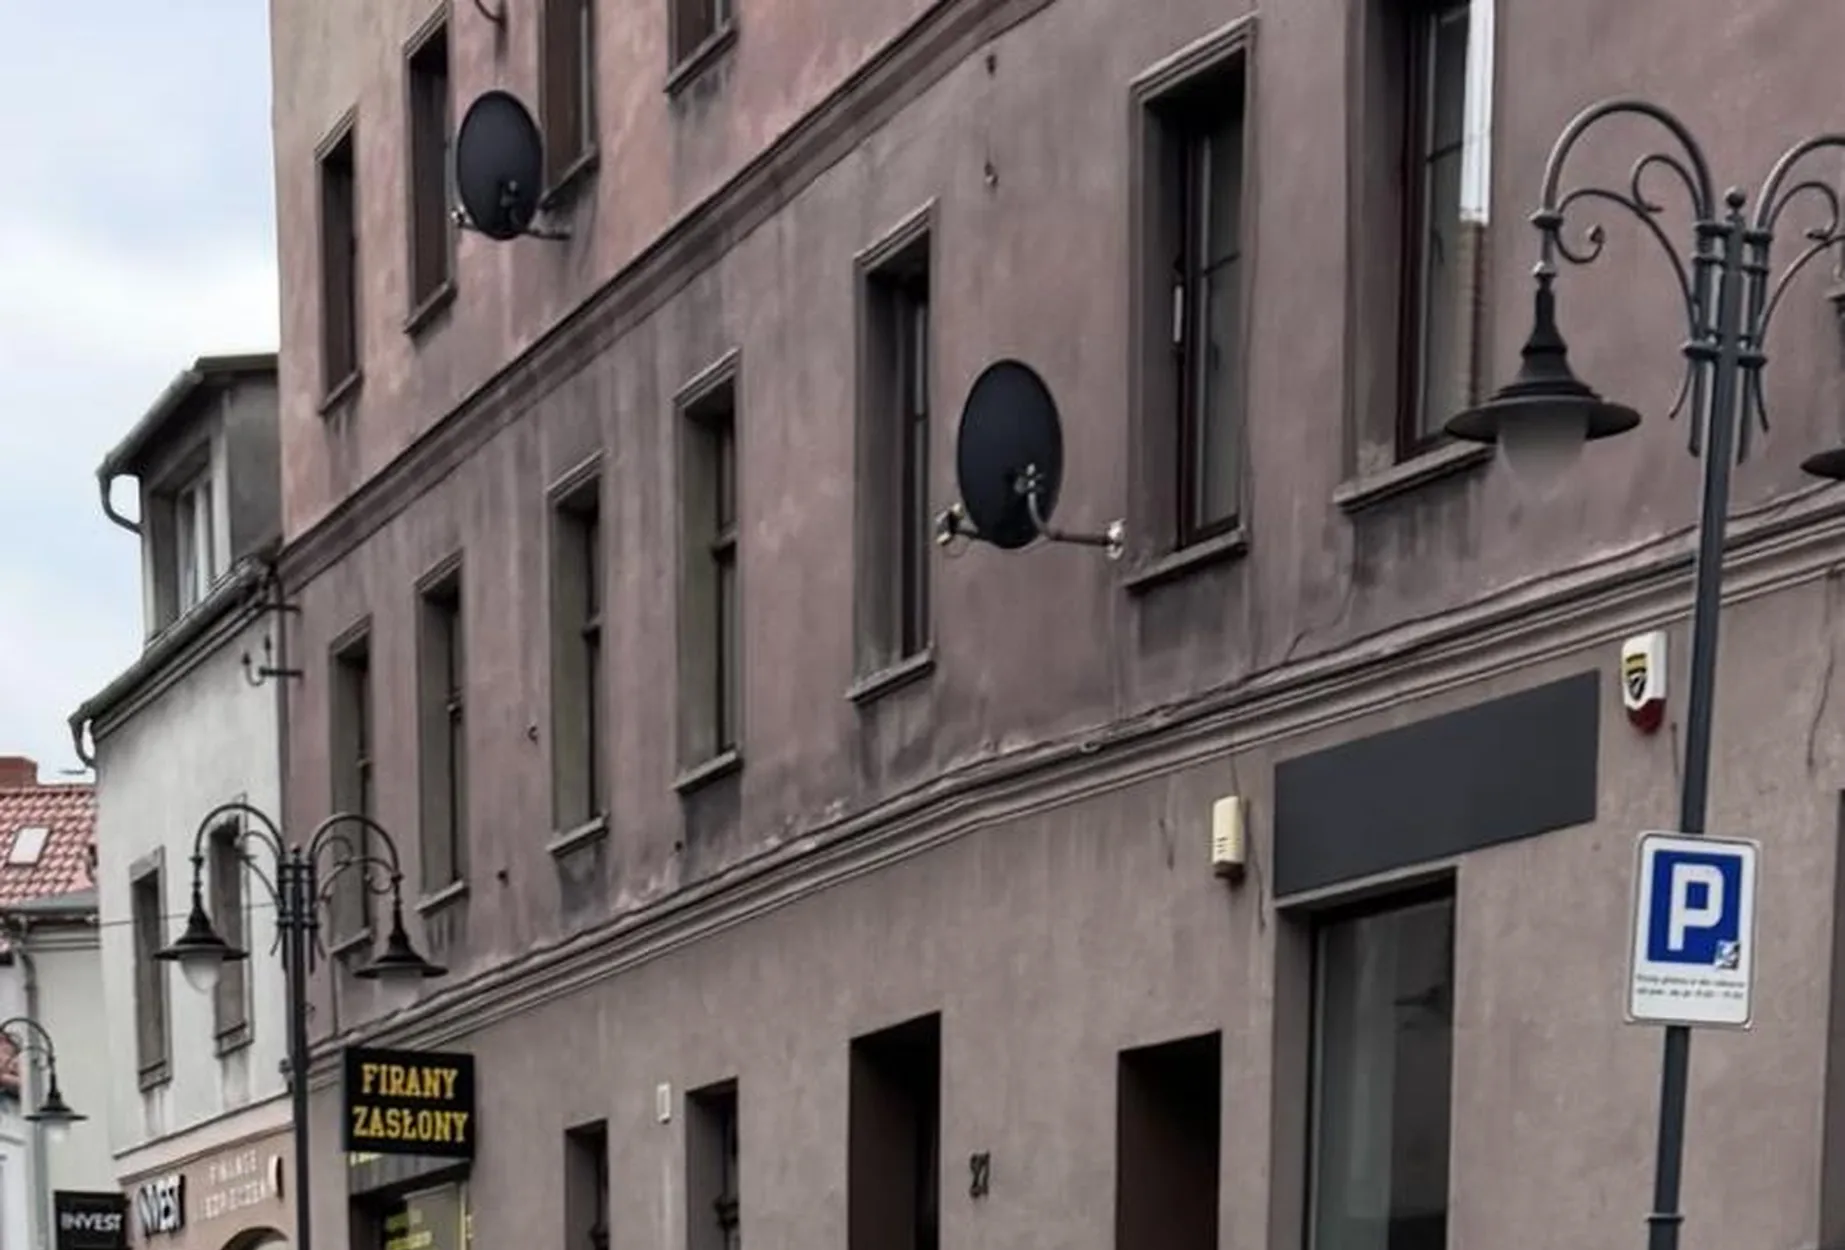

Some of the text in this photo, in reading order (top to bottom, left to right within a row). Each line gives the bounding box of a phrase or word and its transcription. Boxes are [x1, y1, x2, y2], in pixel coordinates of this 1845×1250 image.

[1667, 862, 1725, 952] P
[361, 1062, 459, 1099] FIRANY
[352, 1105, 469, 1142] ZASŁONY
[60, 1210, 123, 1232] INVEST
